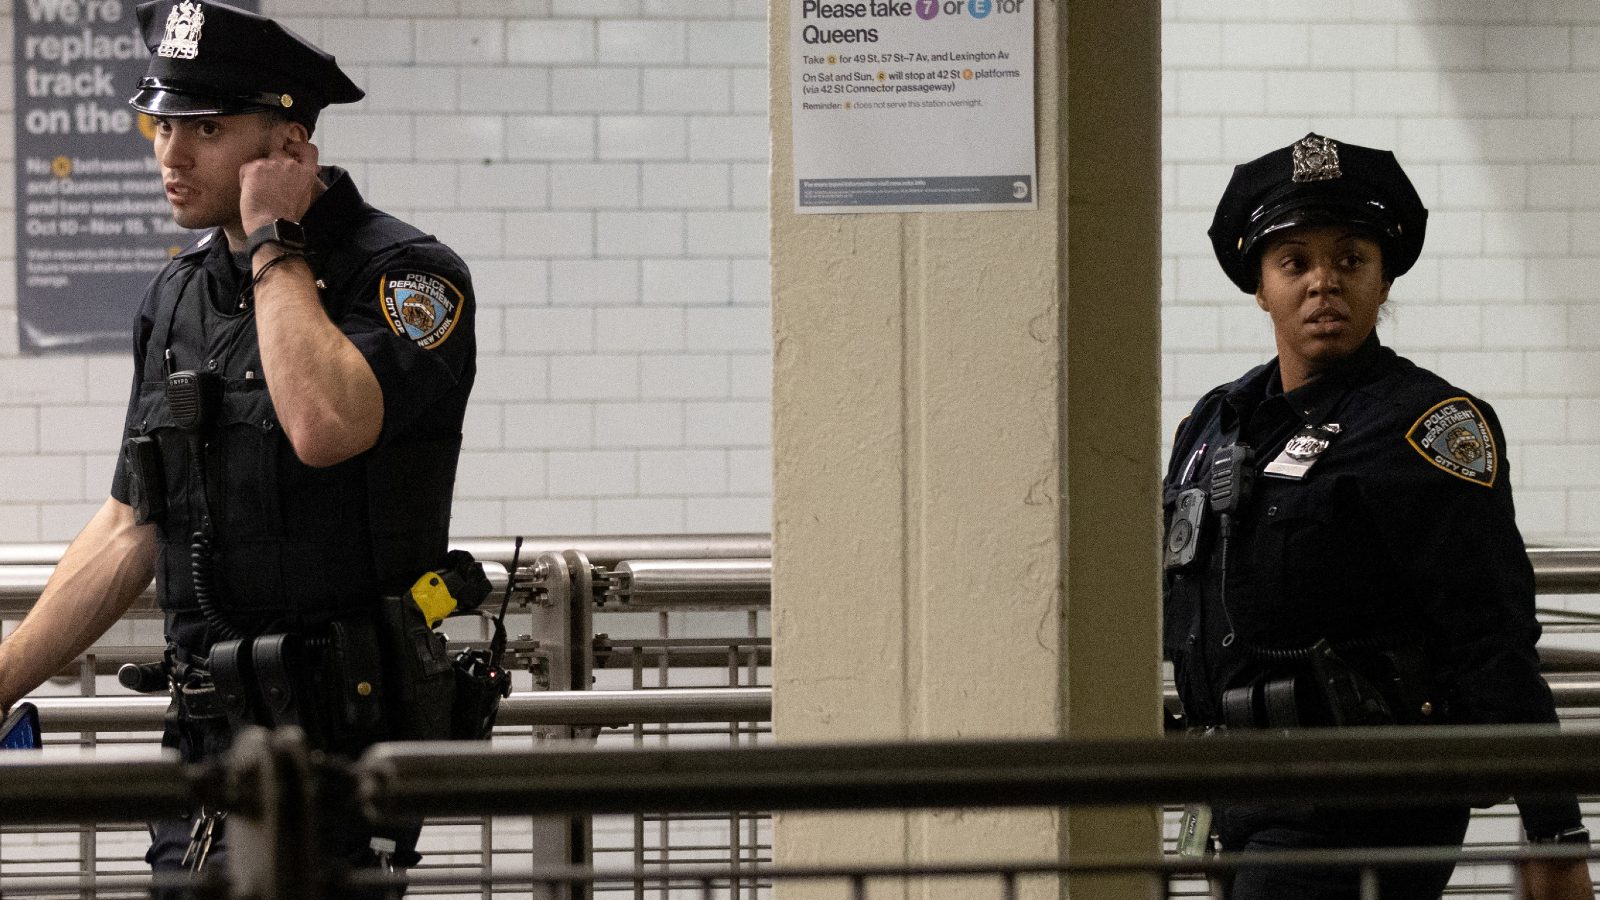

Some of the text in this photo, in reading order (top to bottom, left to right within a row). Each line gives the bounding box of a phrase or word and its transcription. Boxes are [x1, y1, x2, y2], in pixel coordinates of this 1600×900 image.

[25, 0, 122, 23] We're
[802, 0, 867, 18] Please
[869, 0, 913, 17] take
[943, 1, 965, 15] or
[994, 0, 1024, 14] for
[25, 28, 151, 64] replaci
[802, 24, 879, 44] Queens
[803, 55, 825, 65] Take
[839, 54, 852, 64] for
[854, 54, 866, 63] 49
[867, 54, 880, 64] St,
[881, 54, 892, 63] 57
[915, 53, 930, 62] Av,
[931, 52, 948, 62] and
[949, 51, 997, 62] Lexington
[997, 50, 1010, 60] Av
[26, 66, 115, 97] track
[802, 73, 817, 82] On
[818, 72, 835, 82] Sat
[836, 72, 852, 82] and
[853, 72, 875, 82] Sun,
[888, 71, 904, 81] will
[904, 71, 926, 81] stop
[926, 70, 936, 80] at
[936, 70, 949, 80] 42
[950, 69, 961, 79] St
[975, 68, 1020, 80] platforms
[803, 81, 956, 95] (via 42 St Connector passageway)
[803, 101, 842, 111] Reminder:
[853, 101, 872, 109] does
[873, 100, 886, 109] not
[886, 101, 907, 109] serve
[921, 99, 946, 108] station
[26, 102, 131, 134] on the
[406, 273, 446, 294] POLICE
[389, 280, 454, 312] DEPARTMENT
[385, 297, 406, 334] CITY OF
[417, 319, 452, 347] NEW YORK
[1420, 409, 1475, 449] DEPARTMENT
[1423, 404, 1458, 430] POLICE
[1478, 422, 1491, 449] YORK
[1434, 455, 1477, 478] CITY OF
